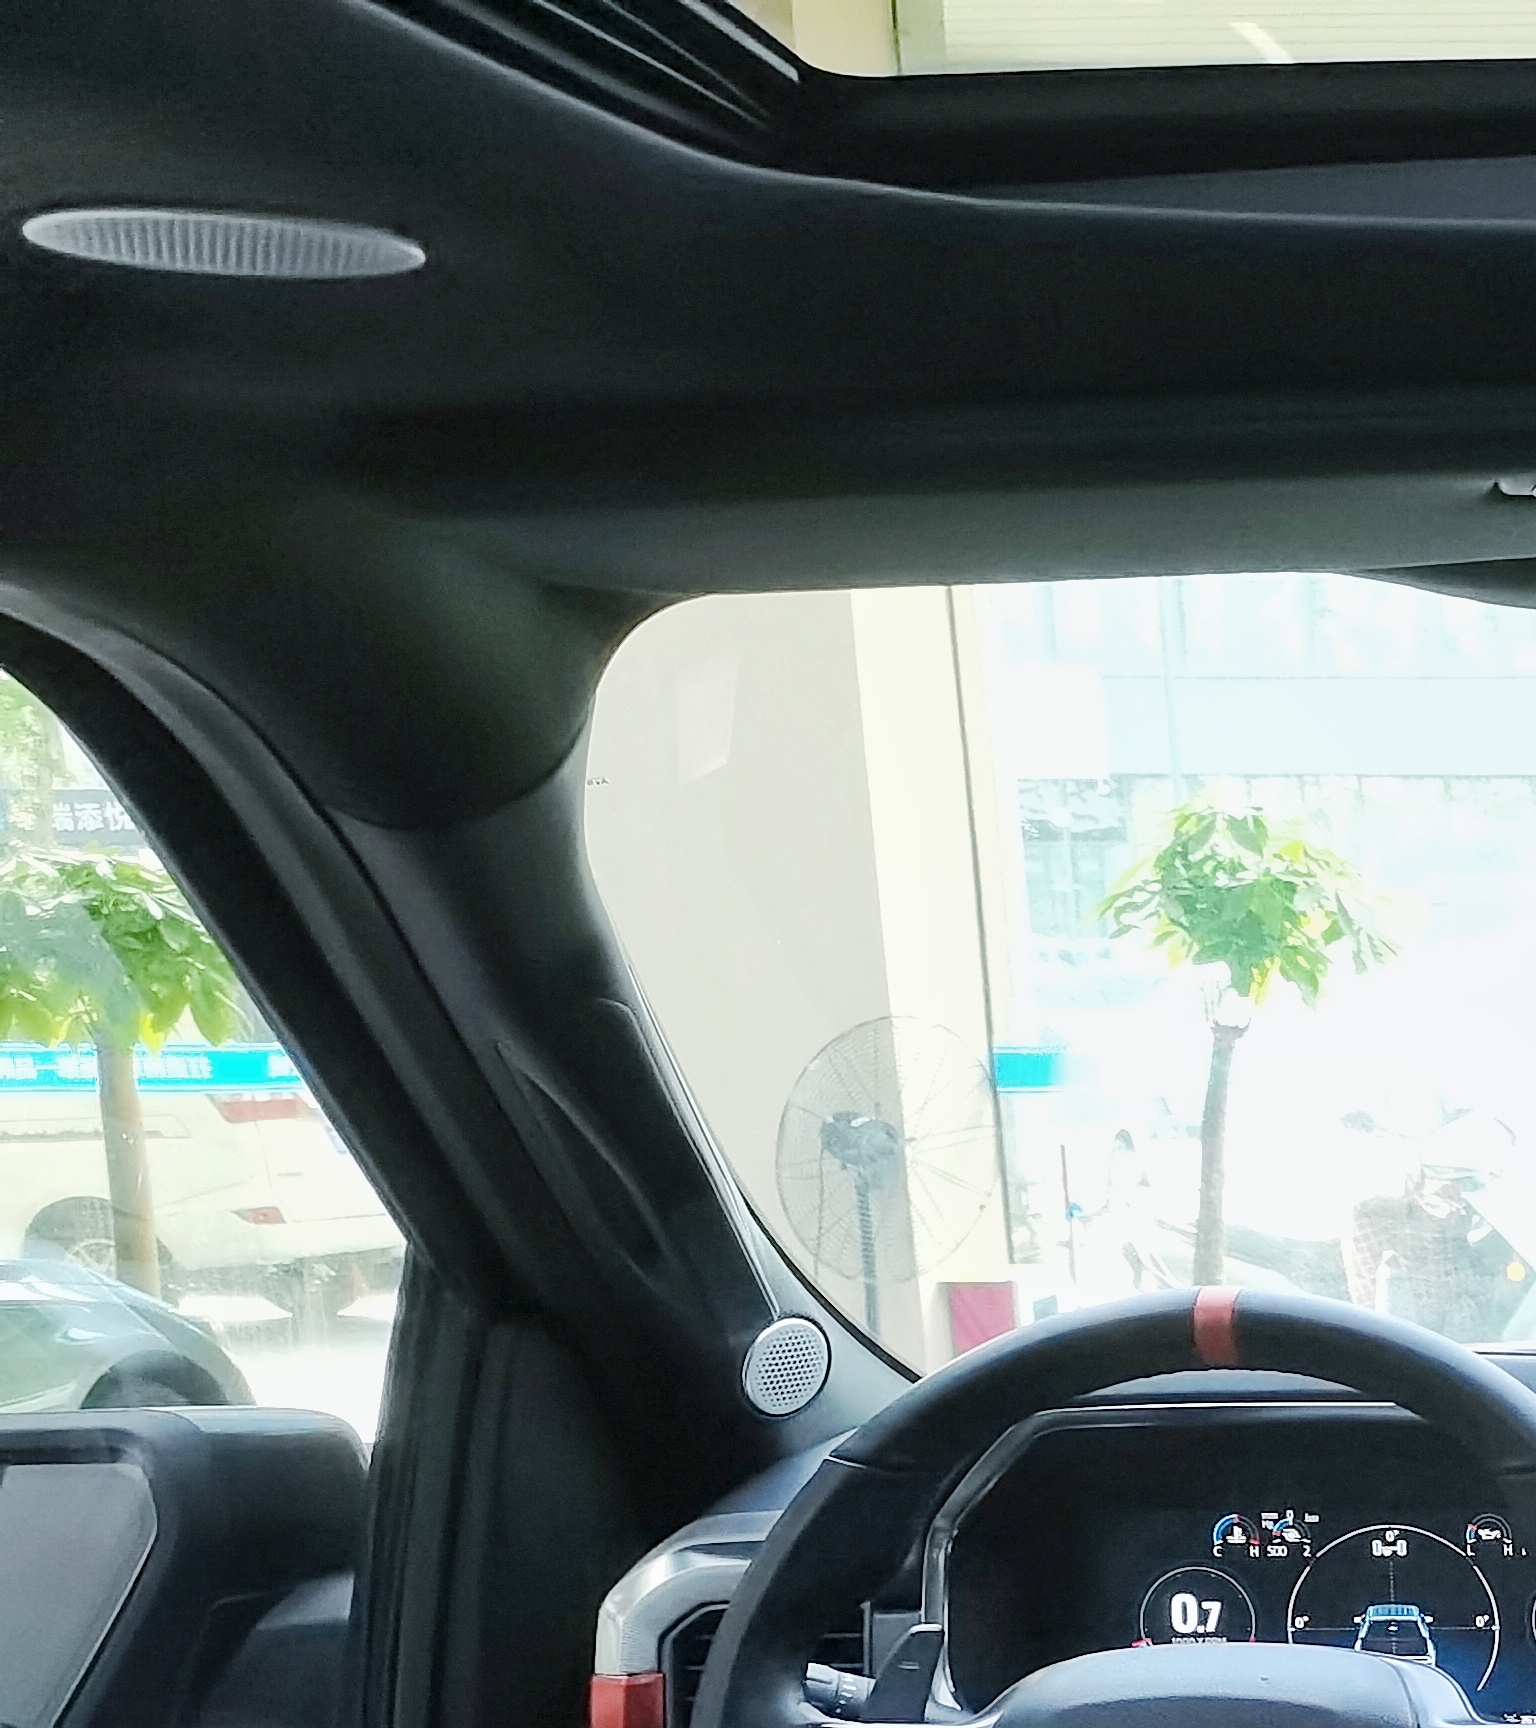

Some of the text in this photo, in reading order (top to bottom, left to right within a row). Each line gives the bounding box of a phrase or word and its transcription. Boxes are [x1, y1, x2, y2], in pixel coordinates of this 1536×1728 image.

[1213, 1546, 1223, 1557] C
[1249, 1545, 1260, 1557] H
[1171, 1593, 1222, 1634] 0.7
